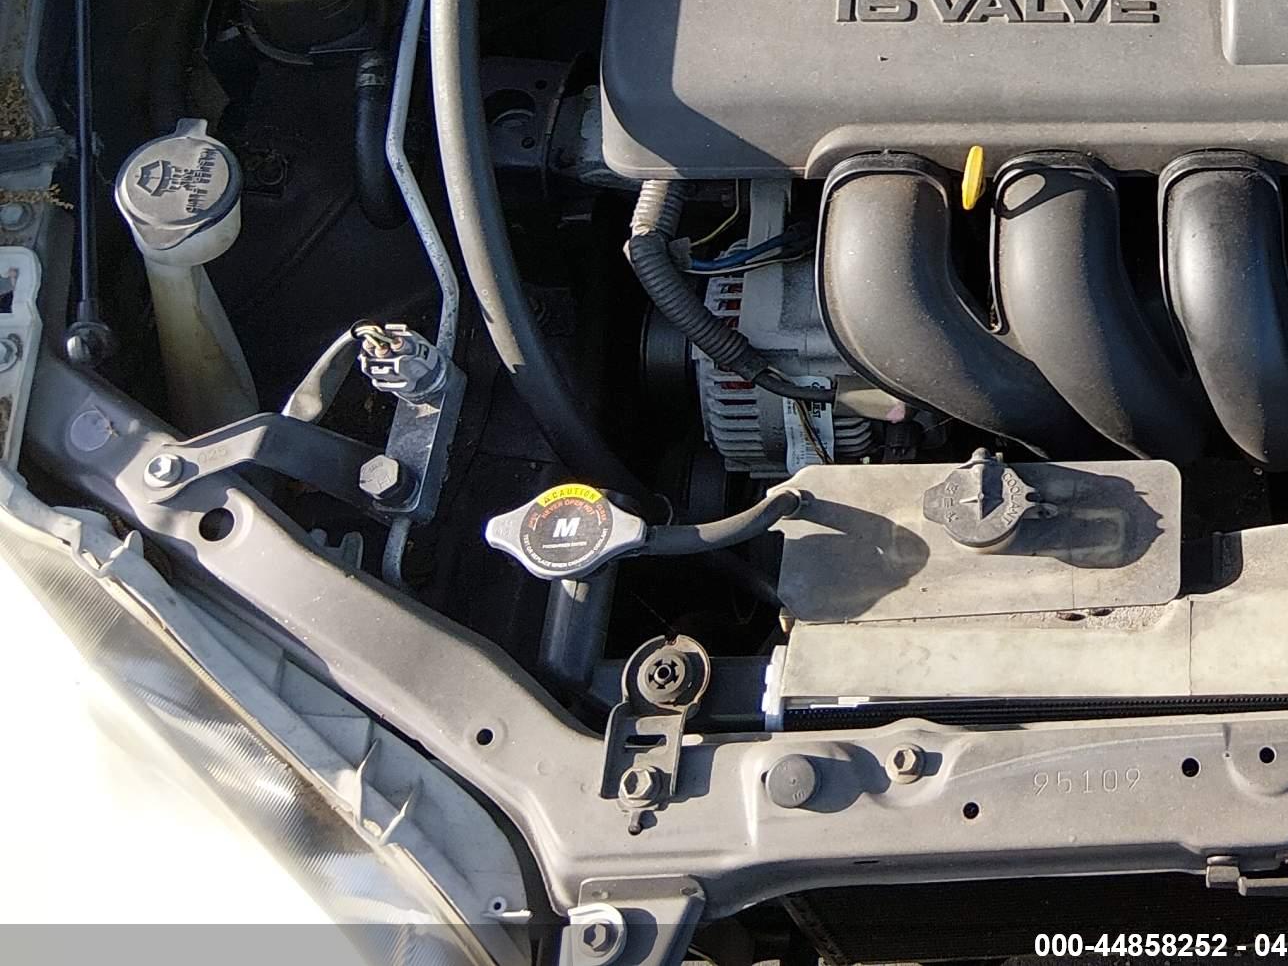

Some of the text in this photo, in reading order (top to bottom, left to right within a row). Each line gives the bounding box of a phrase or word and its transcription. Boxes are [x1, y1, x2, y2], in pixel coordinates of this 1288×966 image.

[551, 486, 596, 501] CAUTION
[563, 498, 585, 508] OPEN
[1002, 472, 1021, 526] COOLANT
[552, 517, 581, 538] M
[1032, 767, 1142, 796] 95109
